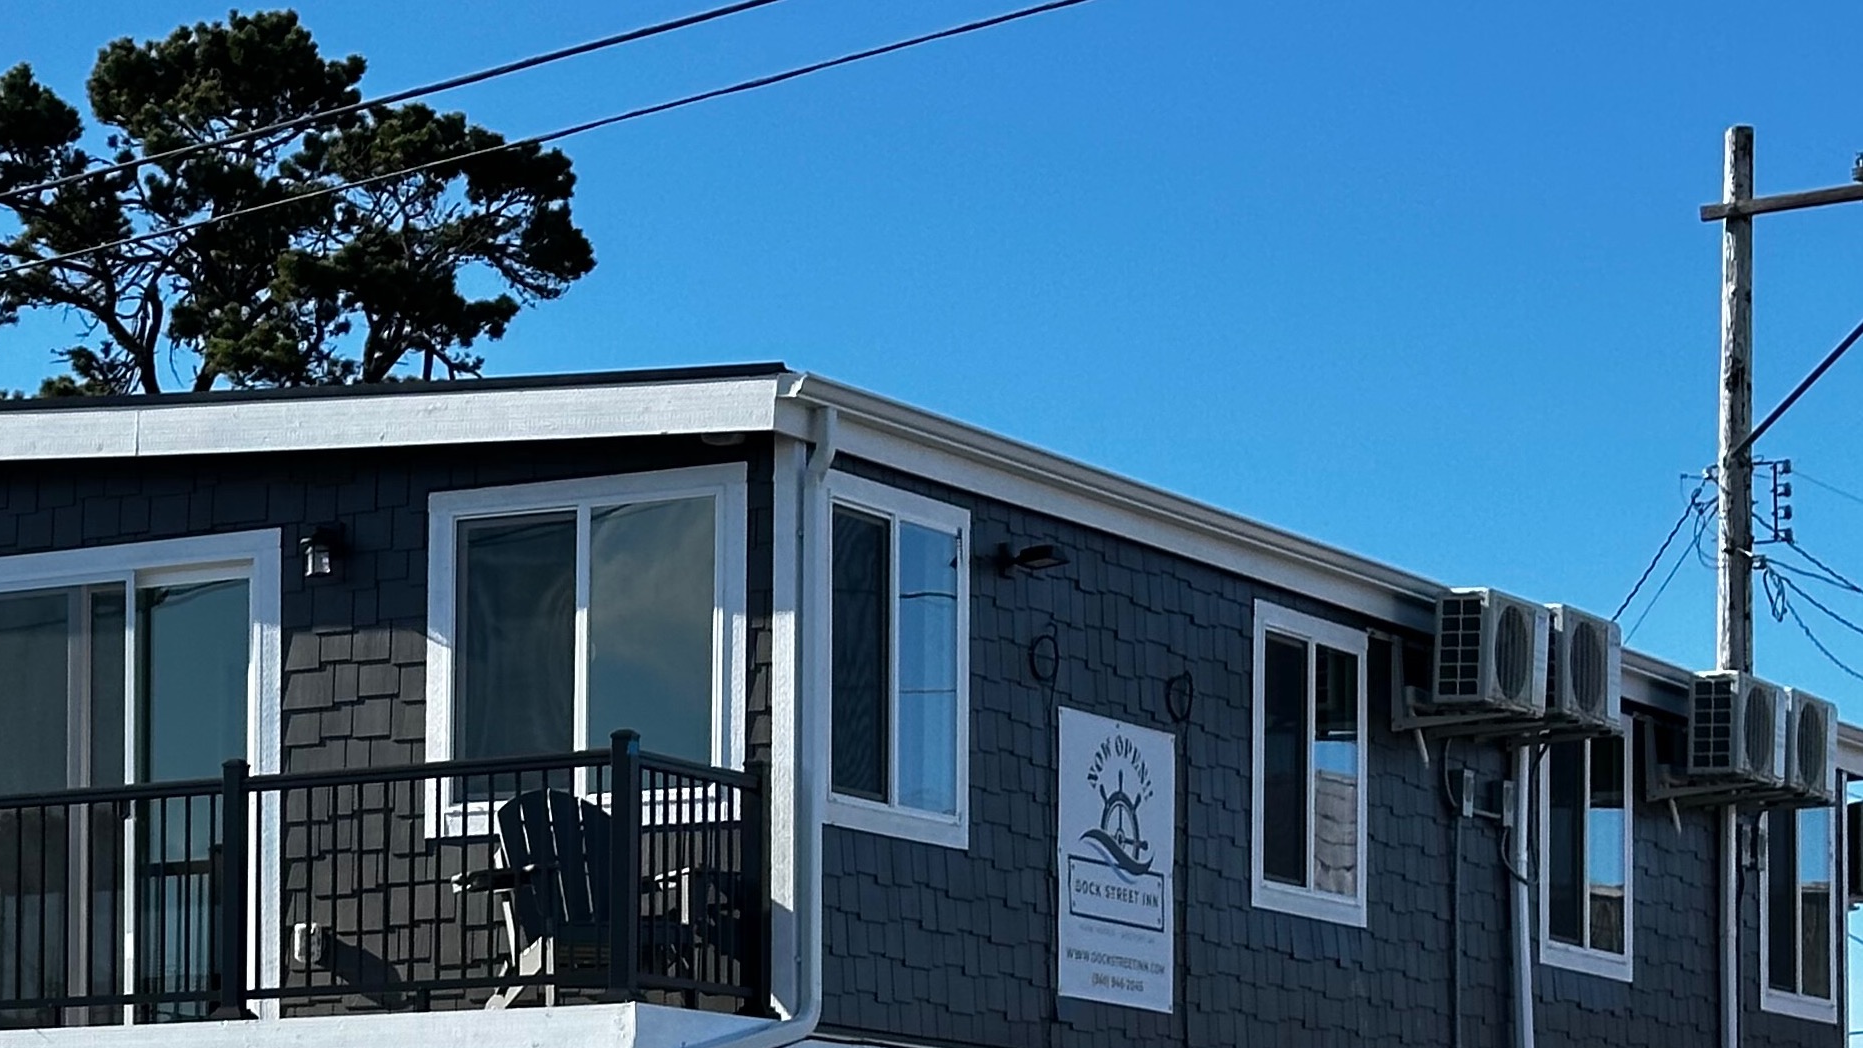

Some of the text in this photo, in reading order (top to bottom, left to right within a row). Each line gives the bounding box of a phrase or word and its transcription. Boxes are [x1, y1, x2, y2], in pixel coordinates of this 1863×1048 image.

[1086, 736, 1112, 789] NOW
[1074, 878, 1160, 908] DOCK STREET INN
